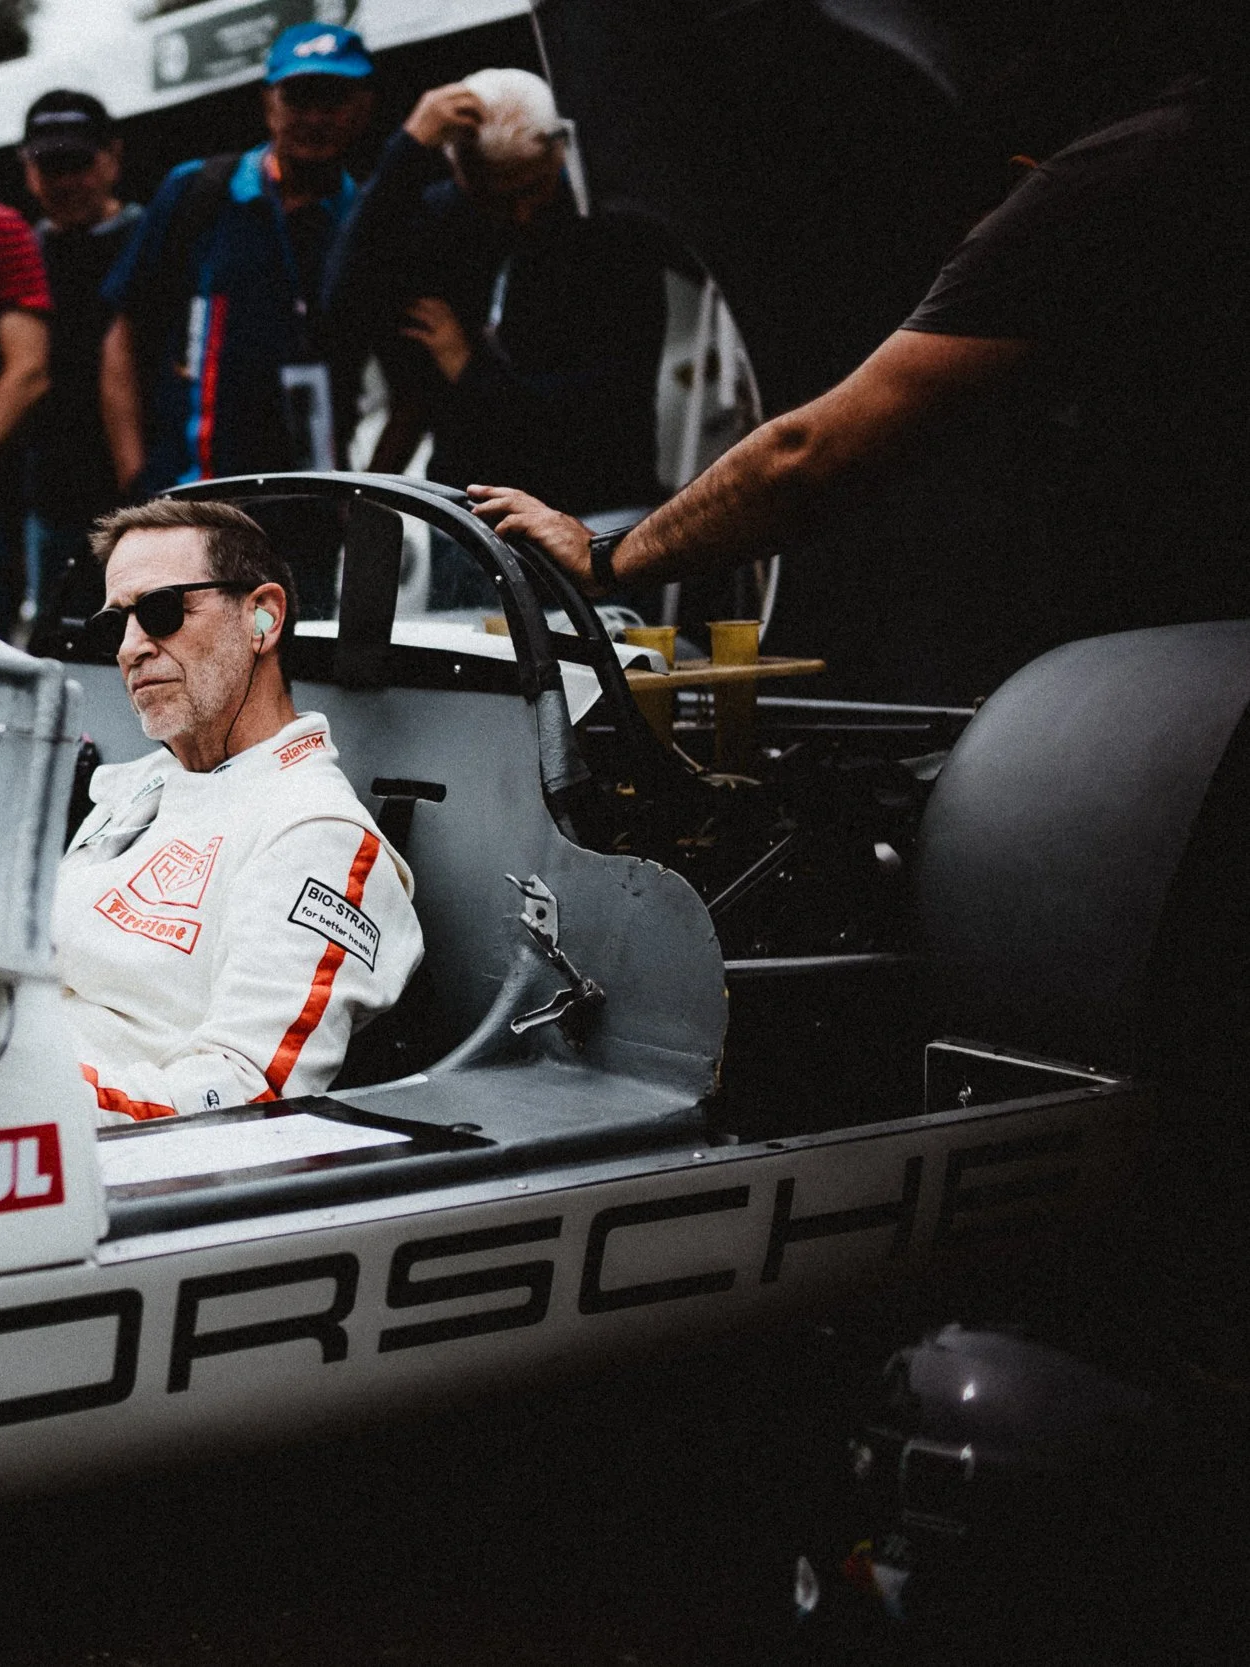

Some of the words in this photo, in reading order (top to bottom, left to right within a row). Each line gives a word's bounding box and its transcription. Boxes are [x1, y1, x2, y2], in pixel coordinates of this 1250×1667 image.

[107, 899, 186, 940] Firestone
[302, 906, 318, 919] for
[319, 915, 347, 937] better
[349, 933, 371, 957] health
[308, 887, 376, 943] BIO-STRATH
